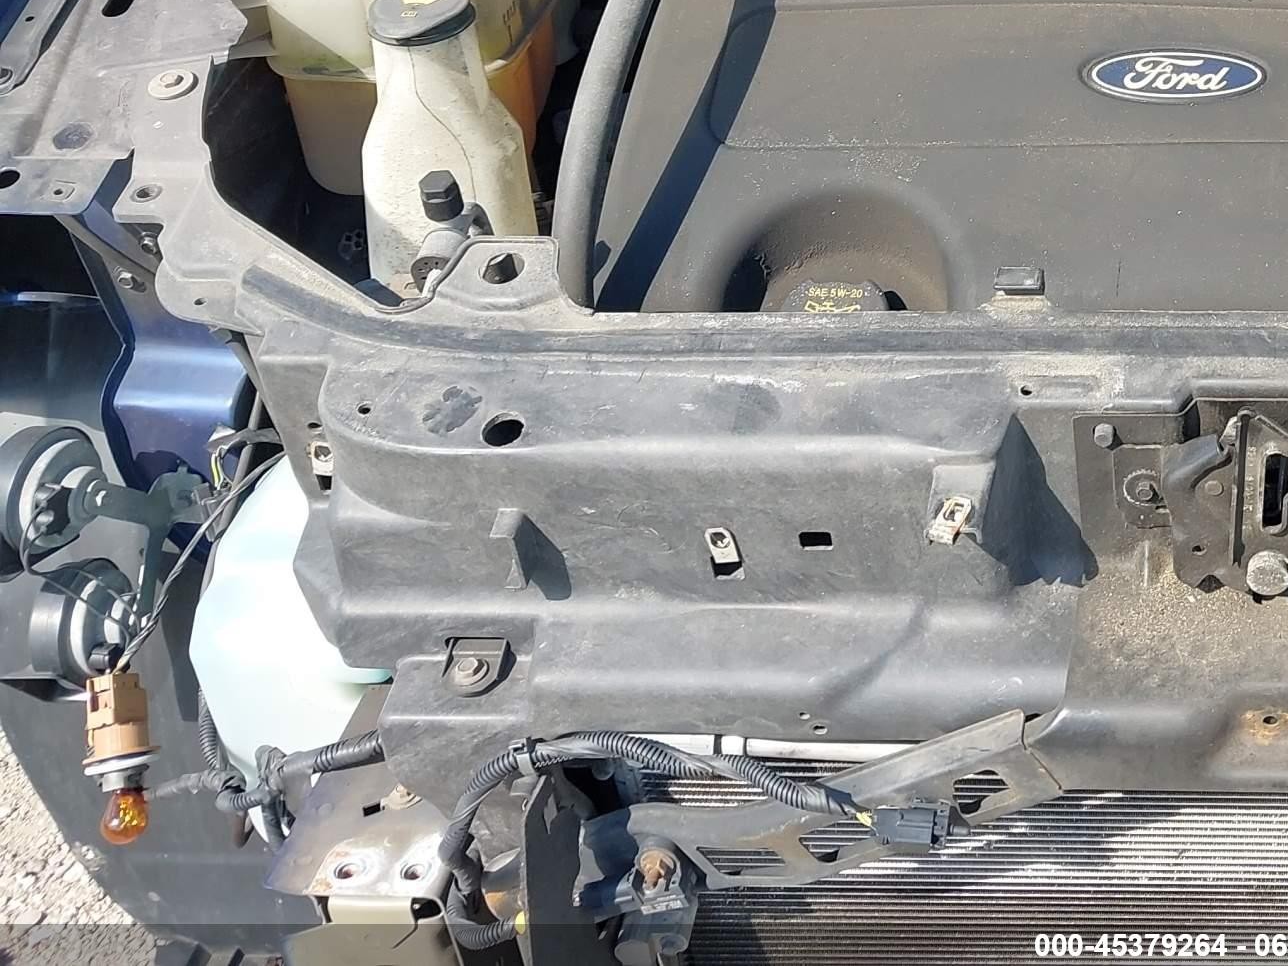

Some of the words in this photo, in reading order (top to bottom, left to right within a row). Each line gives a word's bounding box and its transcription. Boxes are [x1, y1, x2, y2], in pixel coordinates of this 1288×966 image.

[1123, 56, 1228, 91] Ford
[807, 287, 829, 298] SAE
[830, 287, 863, 299] 5W-20
